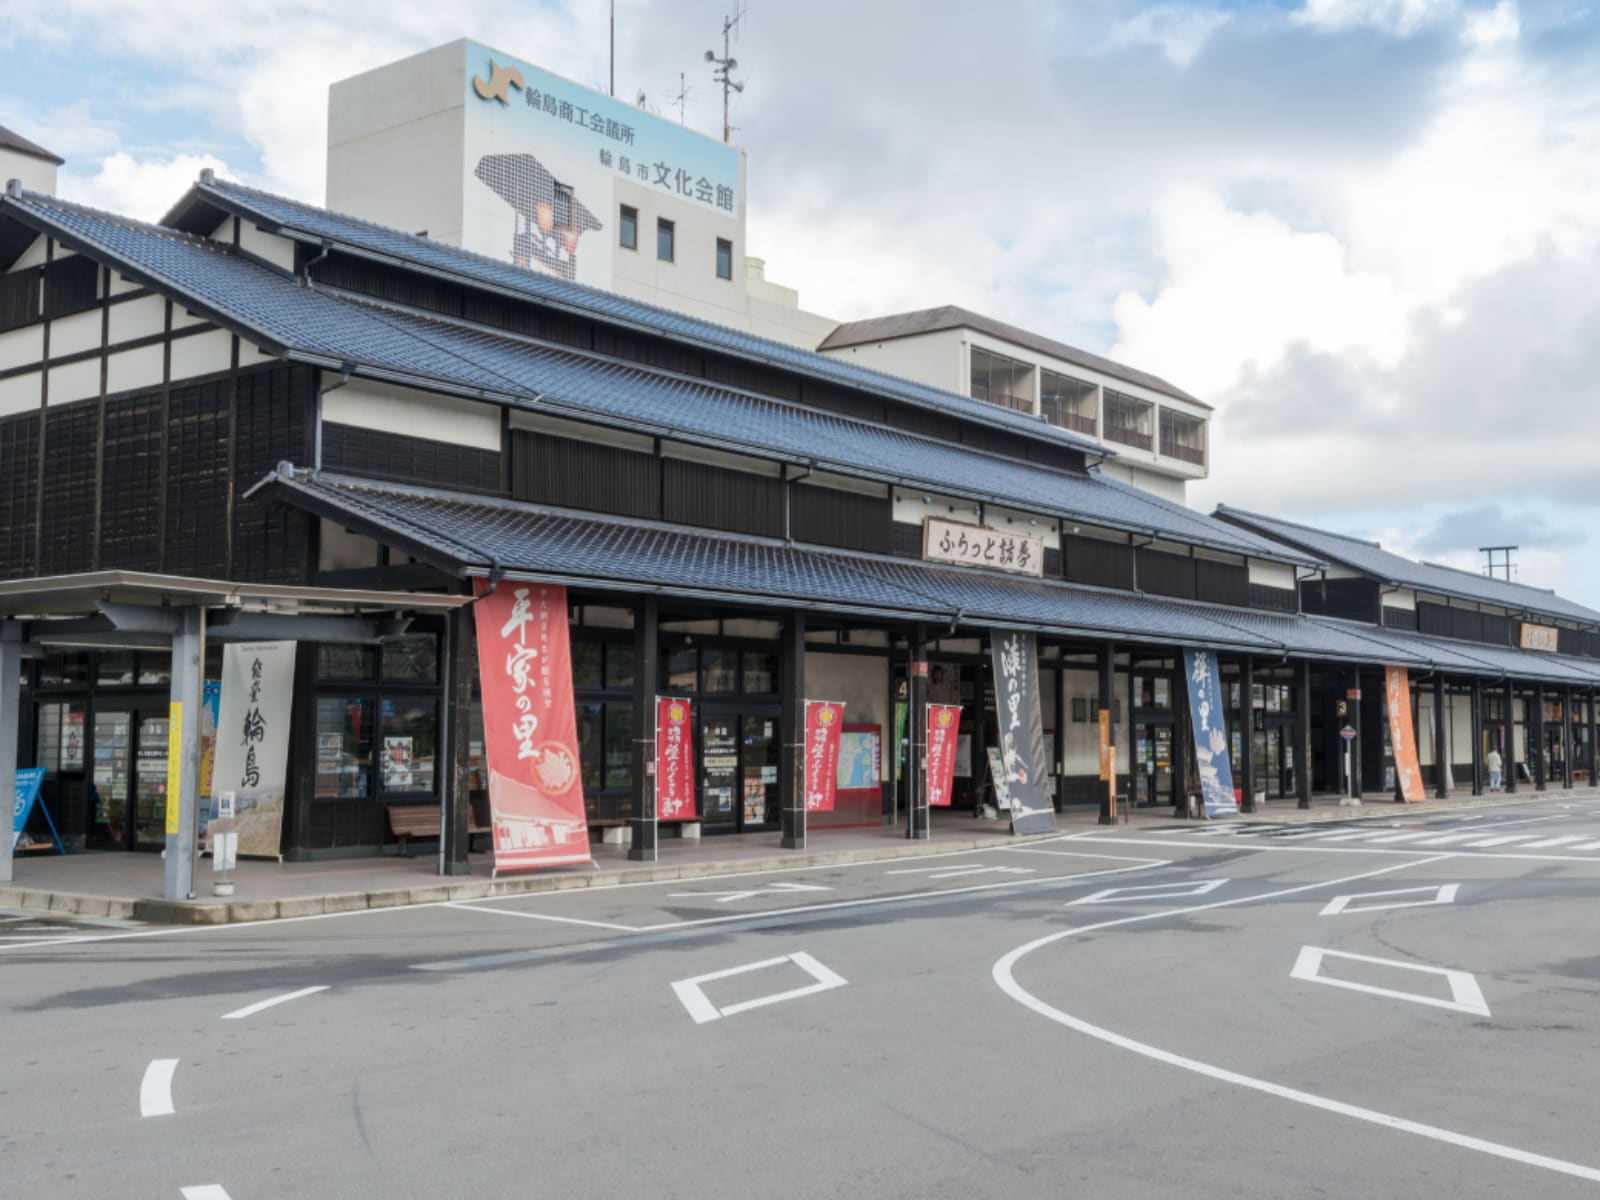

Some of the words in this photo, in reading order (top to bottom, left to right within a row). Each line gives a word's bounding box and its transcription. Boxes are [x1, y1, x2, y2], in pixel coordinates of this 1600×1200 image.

[525, 86, 635, 146] 輪島商工会議所
[599, 148, 734, 212] 輪島市文化会館
[500, 588, 541, 760] 平家の里
